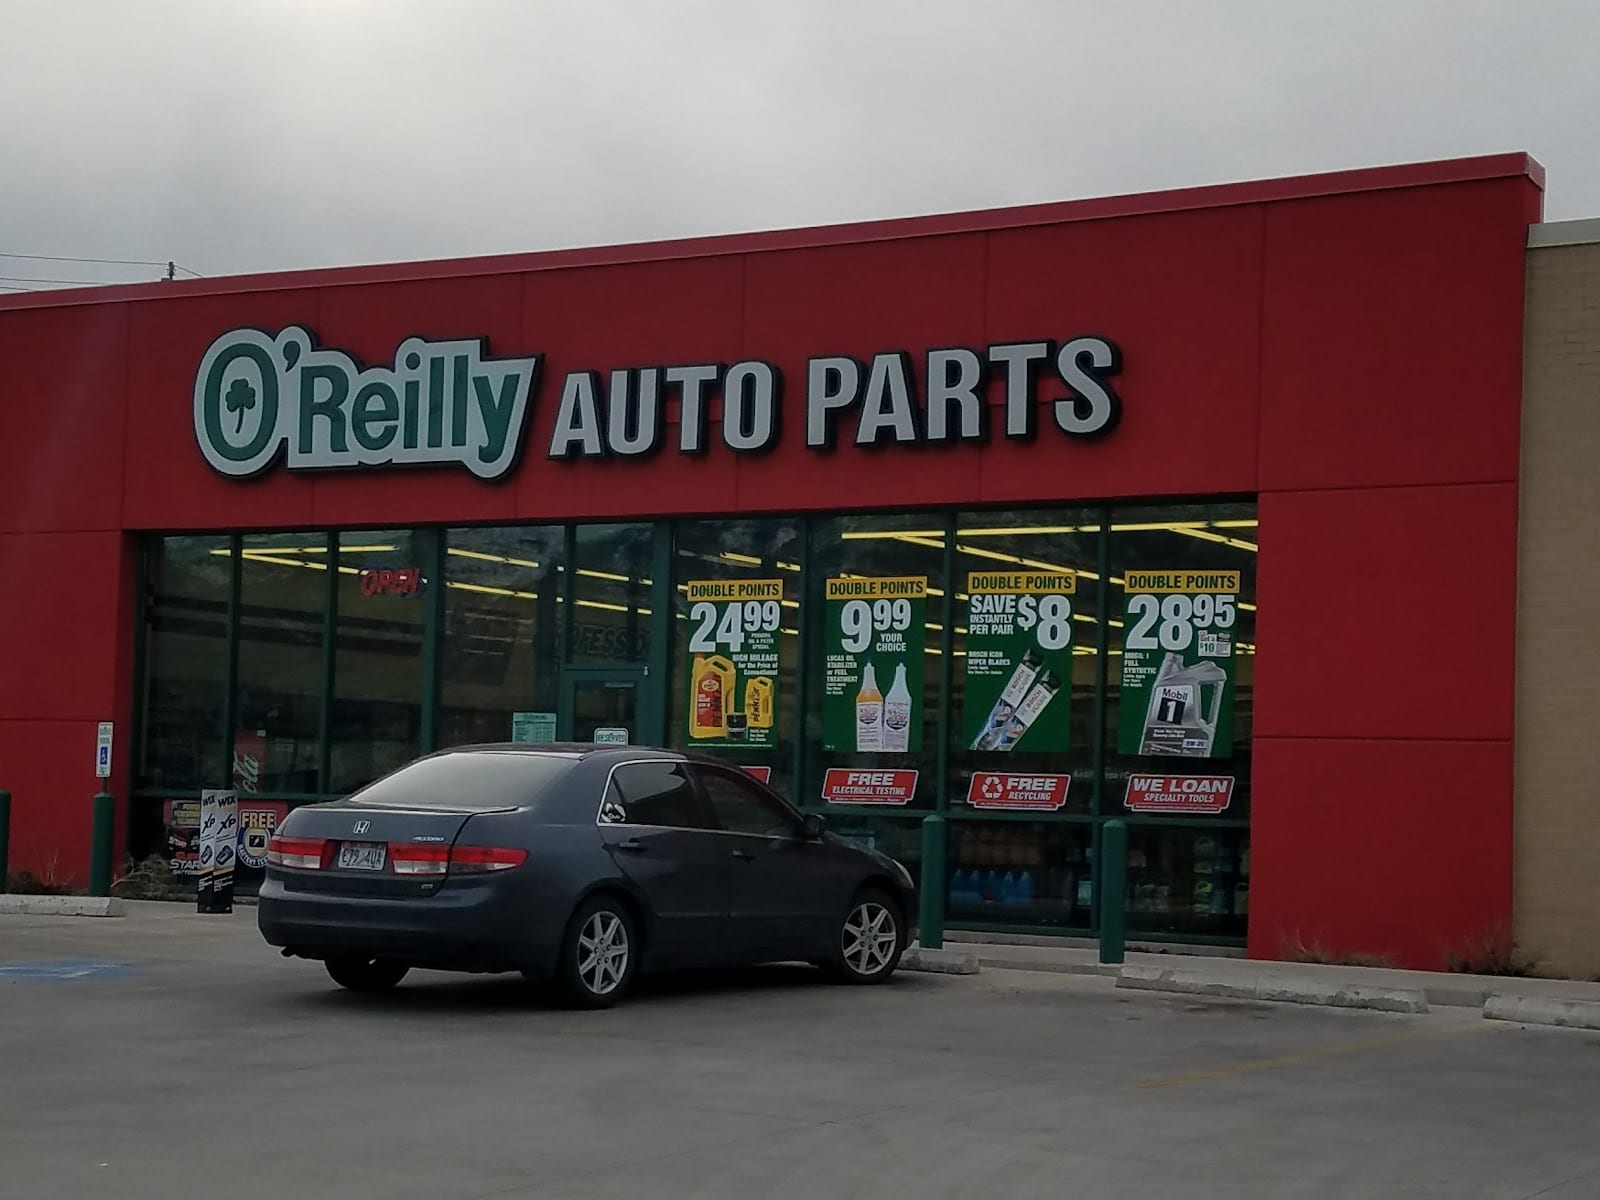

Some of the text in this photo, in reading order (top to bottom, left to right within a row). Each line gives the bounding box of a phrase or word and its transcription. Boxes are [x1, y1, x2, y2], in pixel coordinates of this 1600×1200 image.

[199, 332, 1114, 468] O'Reilly AUTO PARTS
[830, 581, 924, 595] DOUBLE POINTS
[972, 576, 1072, 590] DOUBLE POINTS
[1128, 575, 1236, 589] DOUBLE POINTS
[691, 584, 780, 597] DOUBLE POINTS
[970, 594, 1016, 613] SAVE
[969, 614, 1014, 624] INSTANTLY
[969, 624, 1014, 635] PER PAIR
[880, 633, 903, 643] YOUR
[876, 643, 907, 652] CHOICE
[749, 653, 779, 662] MILEAGE
[1162, 687, 1189, 701] Mobil
[1165, 700, 1178, 722] 1
[846, 773, 895, 786] FREE
[1006, 777, 1058, 791] FREE
[1132, 778, 1229, 793] WE LOAN
[832, 785, 907, 796] ELECTRICAL TESTING
[1008, 791, 1052, 801] RECYCLING
[217, 795, 236, 808] WIX
[1143, 792, 1215, 803] SPECIALTY TOOLS
[216, 813, 237, 835] XP
[241, 812, 275, 829] FREE
